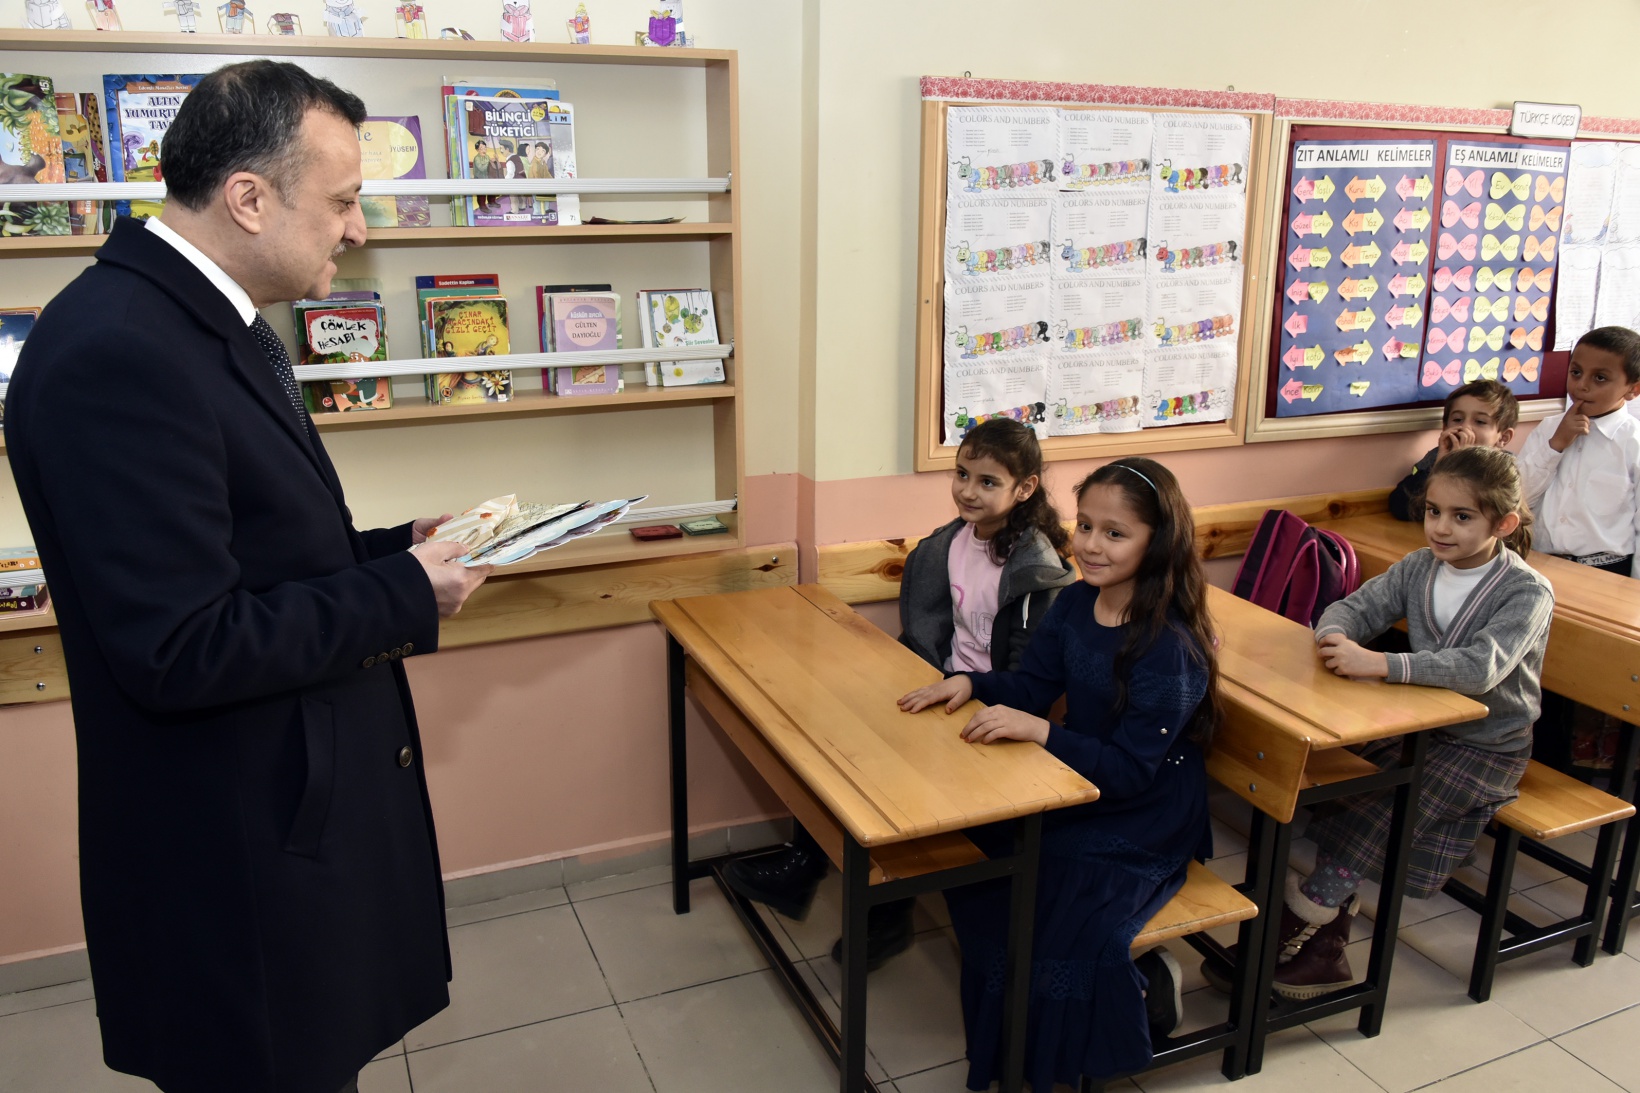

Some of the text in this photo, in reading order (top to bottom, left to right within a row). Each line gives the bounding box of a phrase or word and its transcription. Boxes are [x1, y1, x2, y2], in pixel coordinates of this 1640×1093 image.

[147, 96, 181, 107] ALTIN
[485, 109, 532, 125] BİLİNÇLİ
[959, 114, 1051, 125] COLORS AND NUMBERS
[1520, 111, 1549, 125] TÜRKÇE
[483, 123, 535, 137] TÜKETİCİ
[1163, 120, 1242, 131] COLORS AND NUMBERS
[1297, 147, 1431, 162] ZIT ANLAMLI KELİMELER
[1454, 149, 1563, 168] EŞ ANLAMLI KELİMELER
[957, 199, 1048, 209] COLORS AND NUMBERS
[1159, 201, 1237, 210] COLORS AND NUMBERS
[954, 281, 1044, 296] COLORS AND NUMBERS
[1156, 280, 1184, 289] COLORS
[1200, 278, 1232, 286] NUMBERS
[459, 311, 482, 319] ÇINAR
[320, 319, 367, 332] ÇÖMLEK
[317, 332, 356, 350] HESABI
[1154, 353, 1182, 362] COLORS
[1197, 351, 1229, 359] NUMBERS
[956, 364, 1044, 378] COLORS AND NUMBERS
